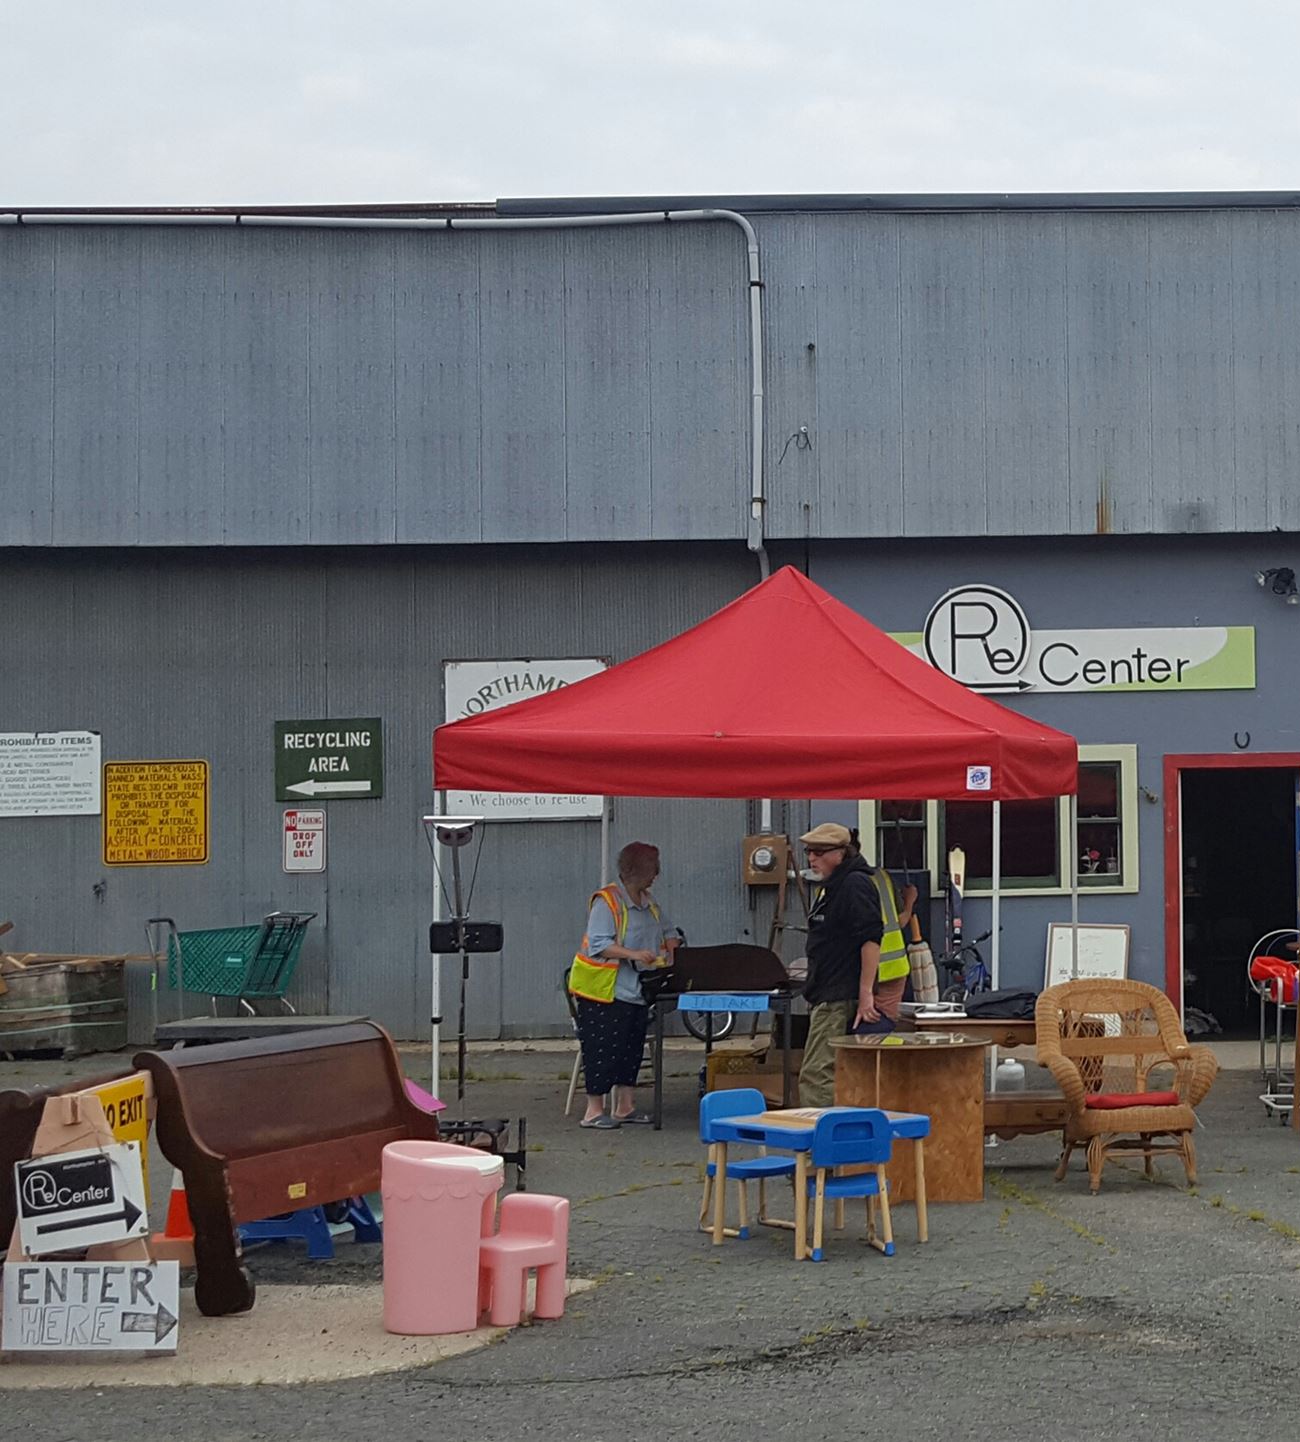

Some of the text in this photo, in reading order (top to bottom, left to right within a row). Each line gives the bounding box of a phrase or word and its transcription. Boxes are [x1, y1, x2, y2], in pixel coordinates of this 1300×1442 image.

[1039, 642, 1190, 686] Center
[0, 737, 92, 746] ROHIBITED ITEMS
[284, 731, 371, 749] RECYCLING
[308, 756, 350, 772] AREA
[108, 775, 134, 783] BANNED
[108, 784, 129, 792] STATE
[166, 791, 200, 799] DISPOSAL
[470, 794, 587, 807] We choose to re-use
[120, 801, 129, 809] OR
[175, 800, 189, 808] FOR
[116, 808, 195, 818] DISPOSAL OF THE
[110, 817, 198, 827] FOLLOWING MATERIALS
[286, 816, 297, 827] NO
[108, 834, 203, 847] ASPHALT CONCRETE
[110, 847, 203, 860] METAL WOOD BRICK
[103, 1095, 143, 1130] O EXIT
[57, 1185, 110, 1206] Center
[18, 1267, 155, 1306] ENTER
[21, 1305, 115, 1346] HERE
